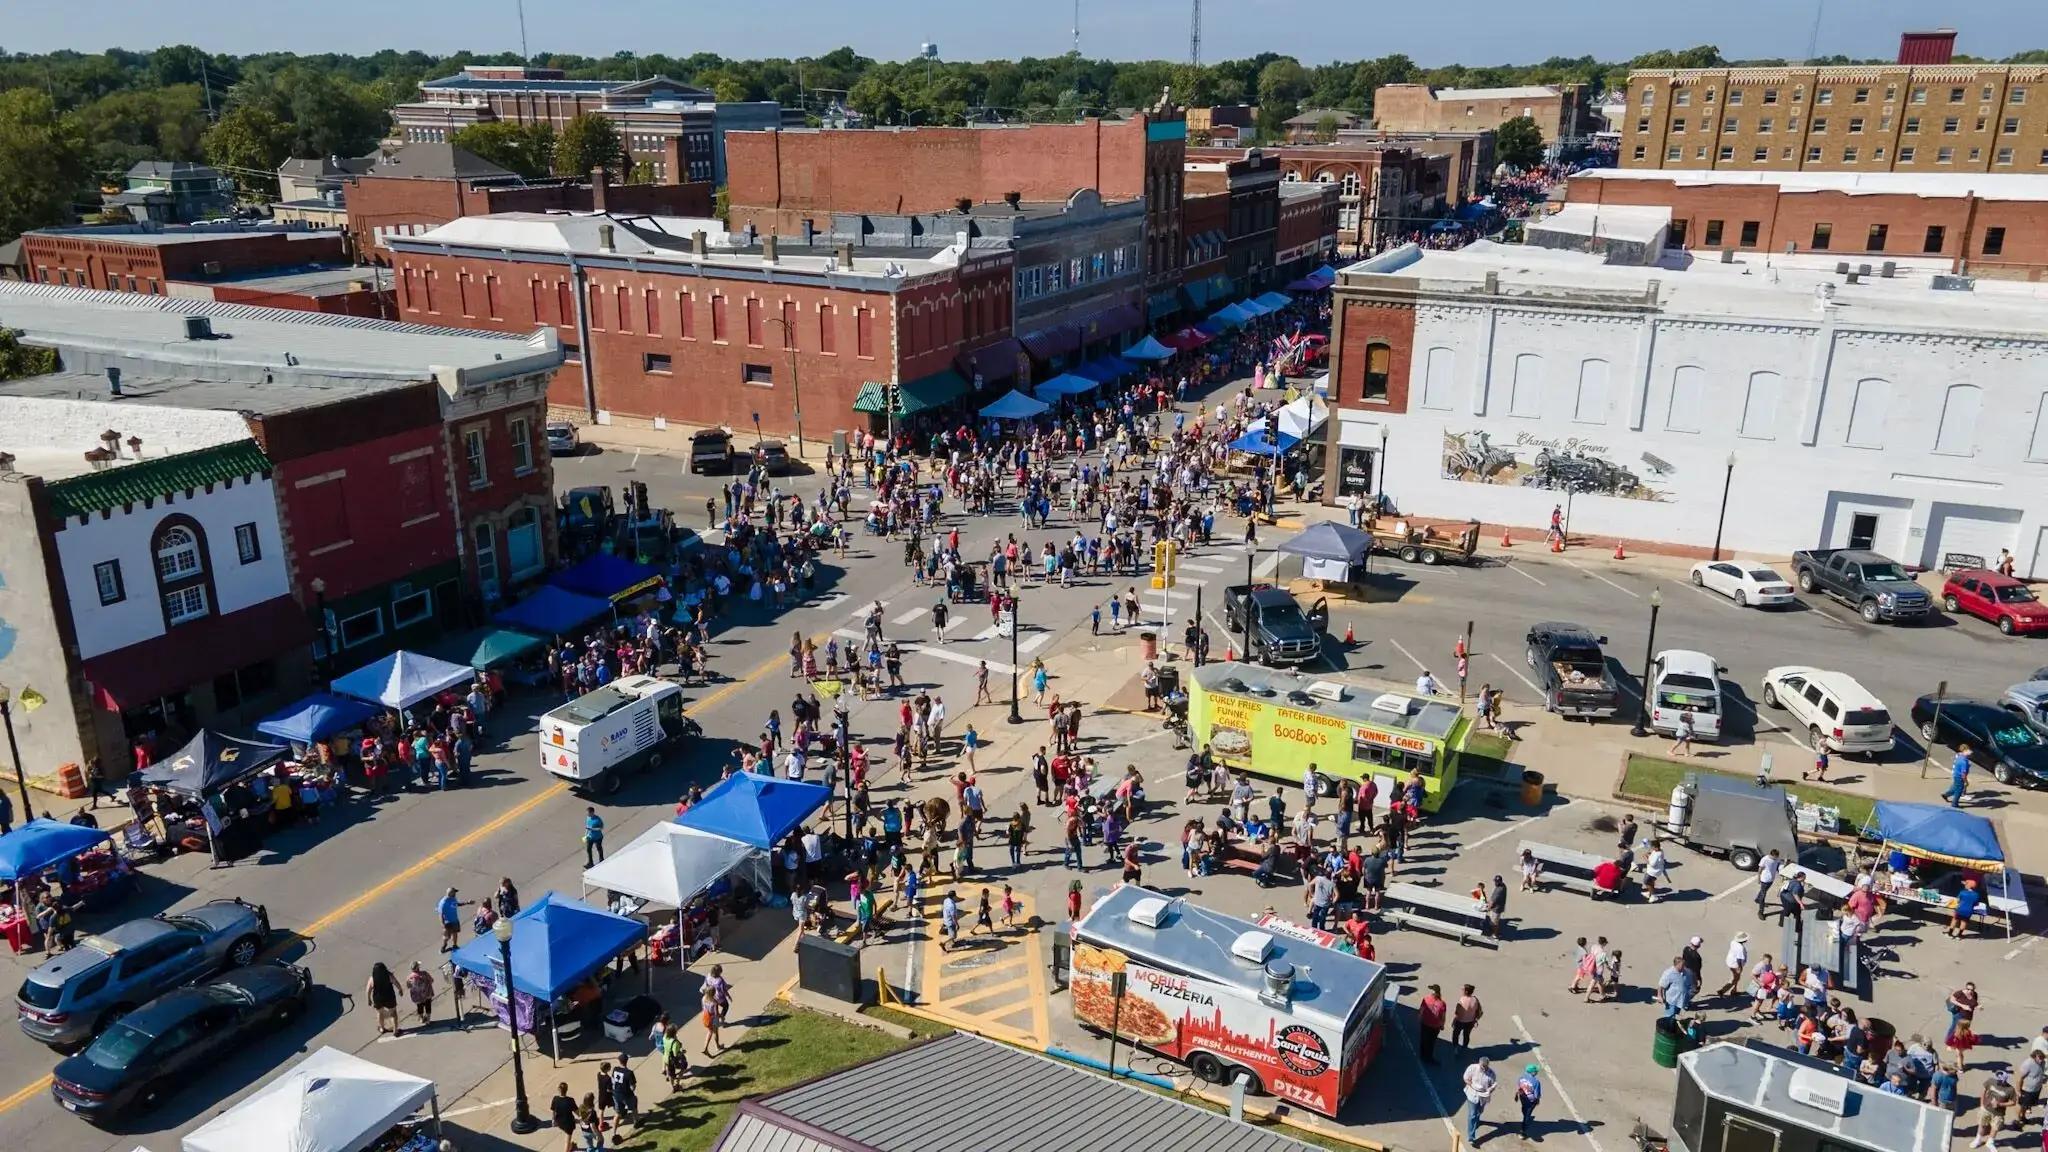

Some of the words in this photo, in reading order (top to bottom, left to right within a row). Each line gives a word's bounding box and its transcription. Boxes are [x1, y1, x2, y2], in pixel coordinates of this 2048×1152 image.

[1565, 437, 1609, 454] Kansas
[1209, 694, 1236, 706] CURLY
[1238, 700, 1262, 712] FRIES
[1216, 706, 1249, 720] FUNNEL
[1218, 717, 1247, 729] CAKES
[1277, 708, 1305, 721] TATER
[1306, 714, 1346, 730] RIBBONS
[610, 727, 629, 741] RAVO
[1357, 729, 1393, 745] FUNNEL
[1395, 737, 1425, 751] CAKES
[1134, 969, 1189, 991] MOBILE
[1150, 982, 1215, 1007] PIZZERIA
[1286, 1026, 1323, 1045] ITALIAN
[1191, 1036, 1223, 1052] FRESH,
[1224, 1044, 1279, 1065] AUTHENTIC
[1280, 1053, 1325, 1076] RESTAURANT
[1273, 1078, 1327, 1110] PIZZA
